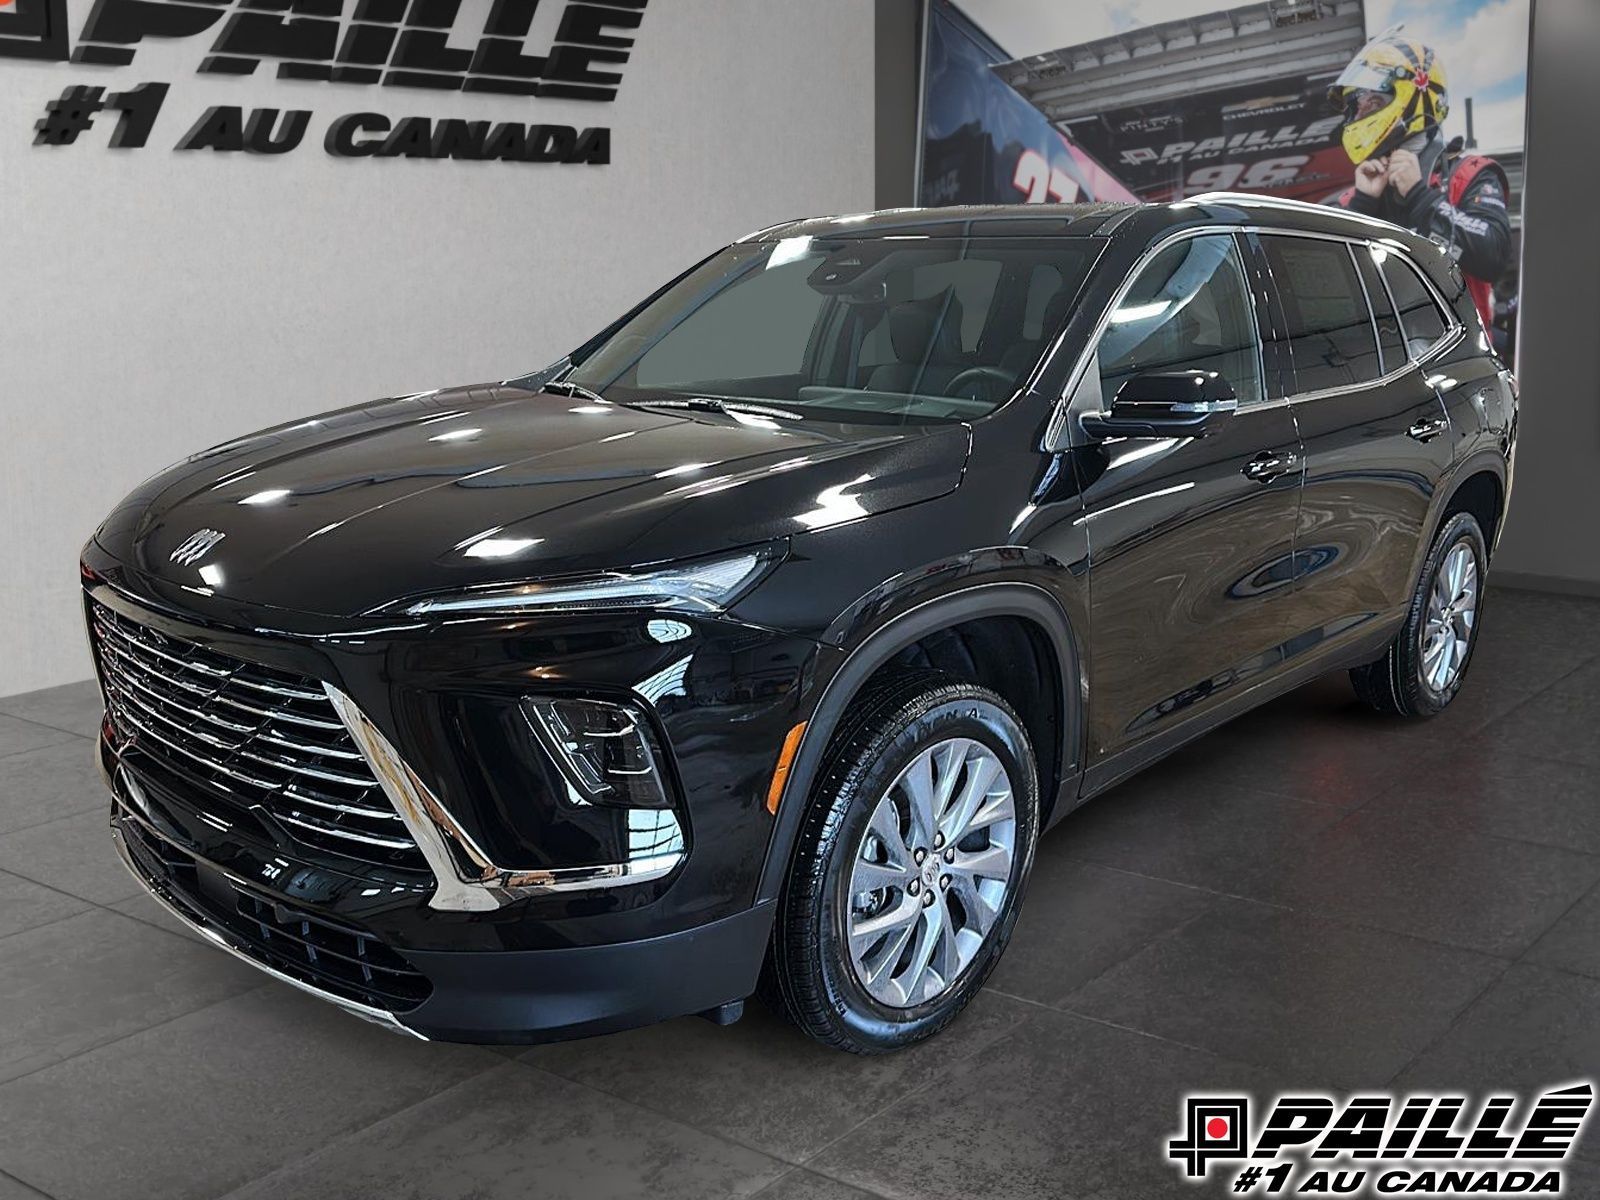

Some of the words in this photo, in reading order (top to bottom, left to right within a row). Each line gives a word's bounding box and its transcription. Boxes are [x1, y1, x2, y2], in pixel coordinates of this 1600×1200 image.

[32, 82, 171, 148] #1
[173, 106, 313, 154] AU
[323, 112, 611, 164] CANADA
[1222, 103, 1306, 121] CHEVROLET
[1189, 150, 1221, 161] AU
[1228, 135, 1331, 155] CANADA
[1183, 155, 1310, 194] 96
